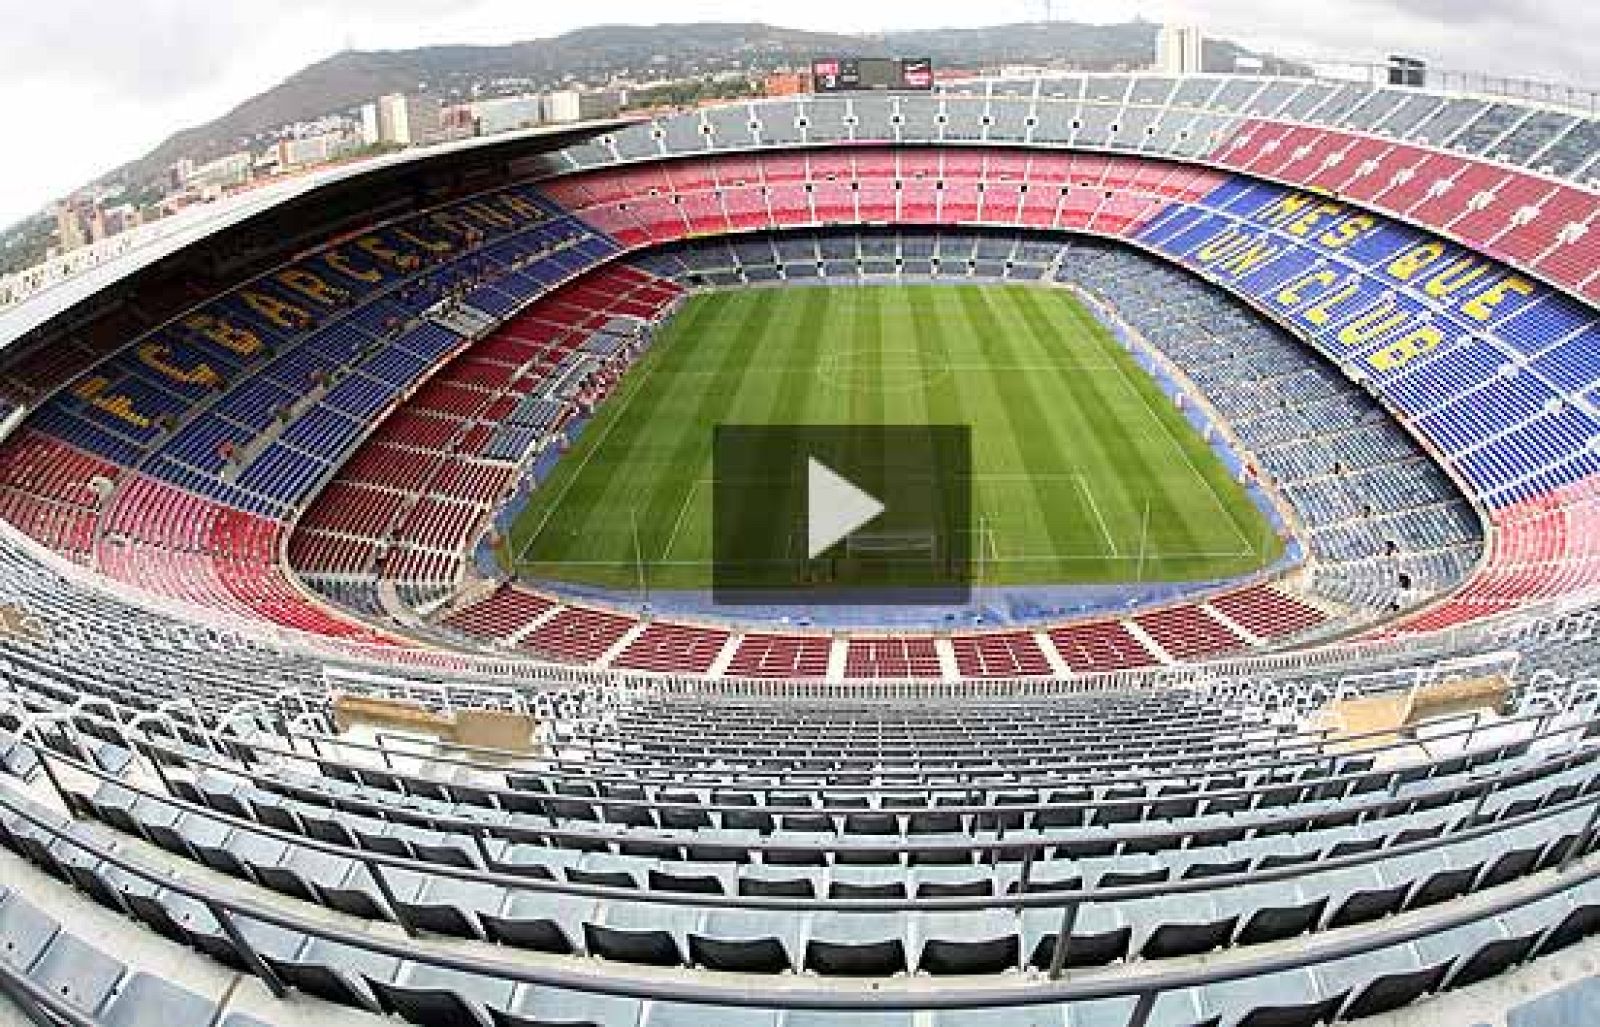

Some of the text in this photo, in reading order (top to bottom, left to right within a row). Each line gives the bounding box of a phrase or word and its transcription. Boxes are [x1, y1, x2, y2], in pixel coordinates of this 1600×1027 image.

[1197, 227, 1442, 370] UN CLUB
[1387, 243, 1534, 320] QUE
